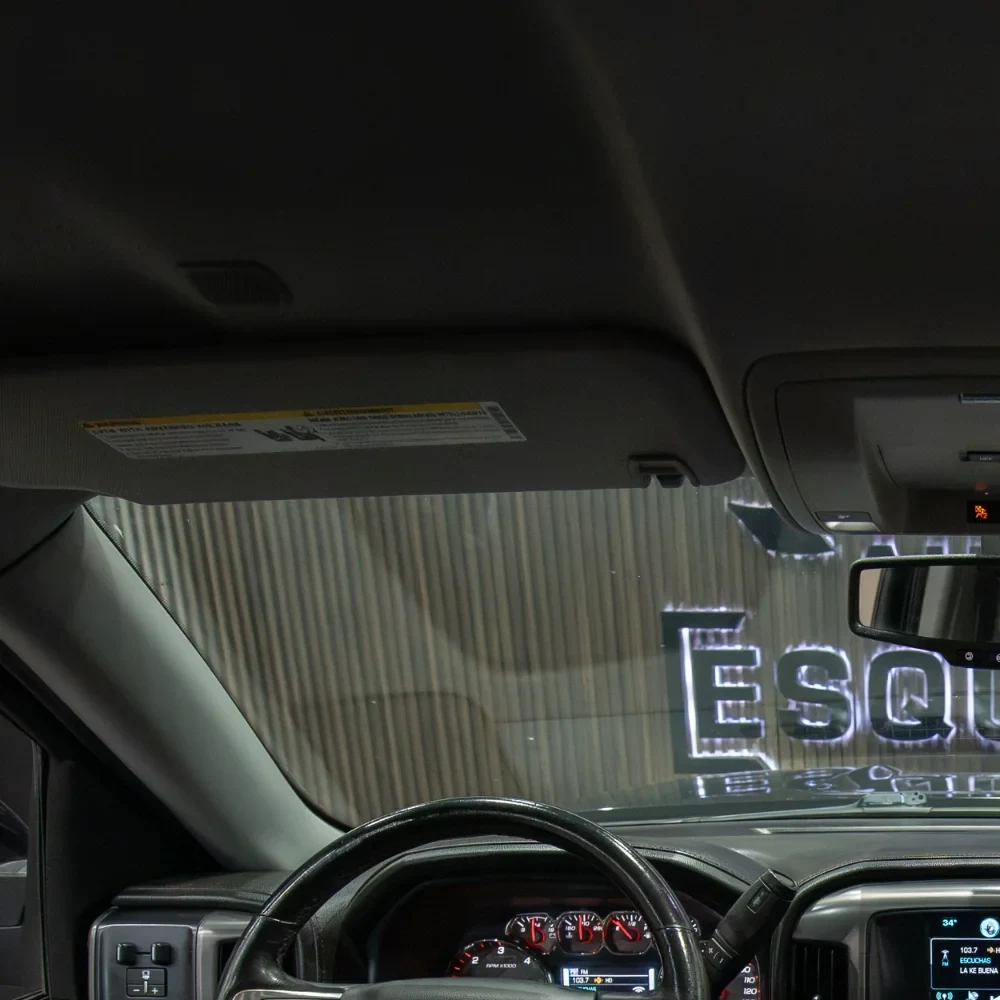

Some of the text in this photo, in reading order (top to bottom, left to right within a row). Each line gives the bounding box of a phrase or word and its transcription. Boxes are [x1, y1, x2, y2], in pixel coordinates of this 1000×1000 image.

[497, 946, 505, 955] 3
[471, 956, 479, 964] 2
[523, 956, 531, 965] 4
[743, 976, 756, 984] 110
[743, 987, 758, 995] 120
